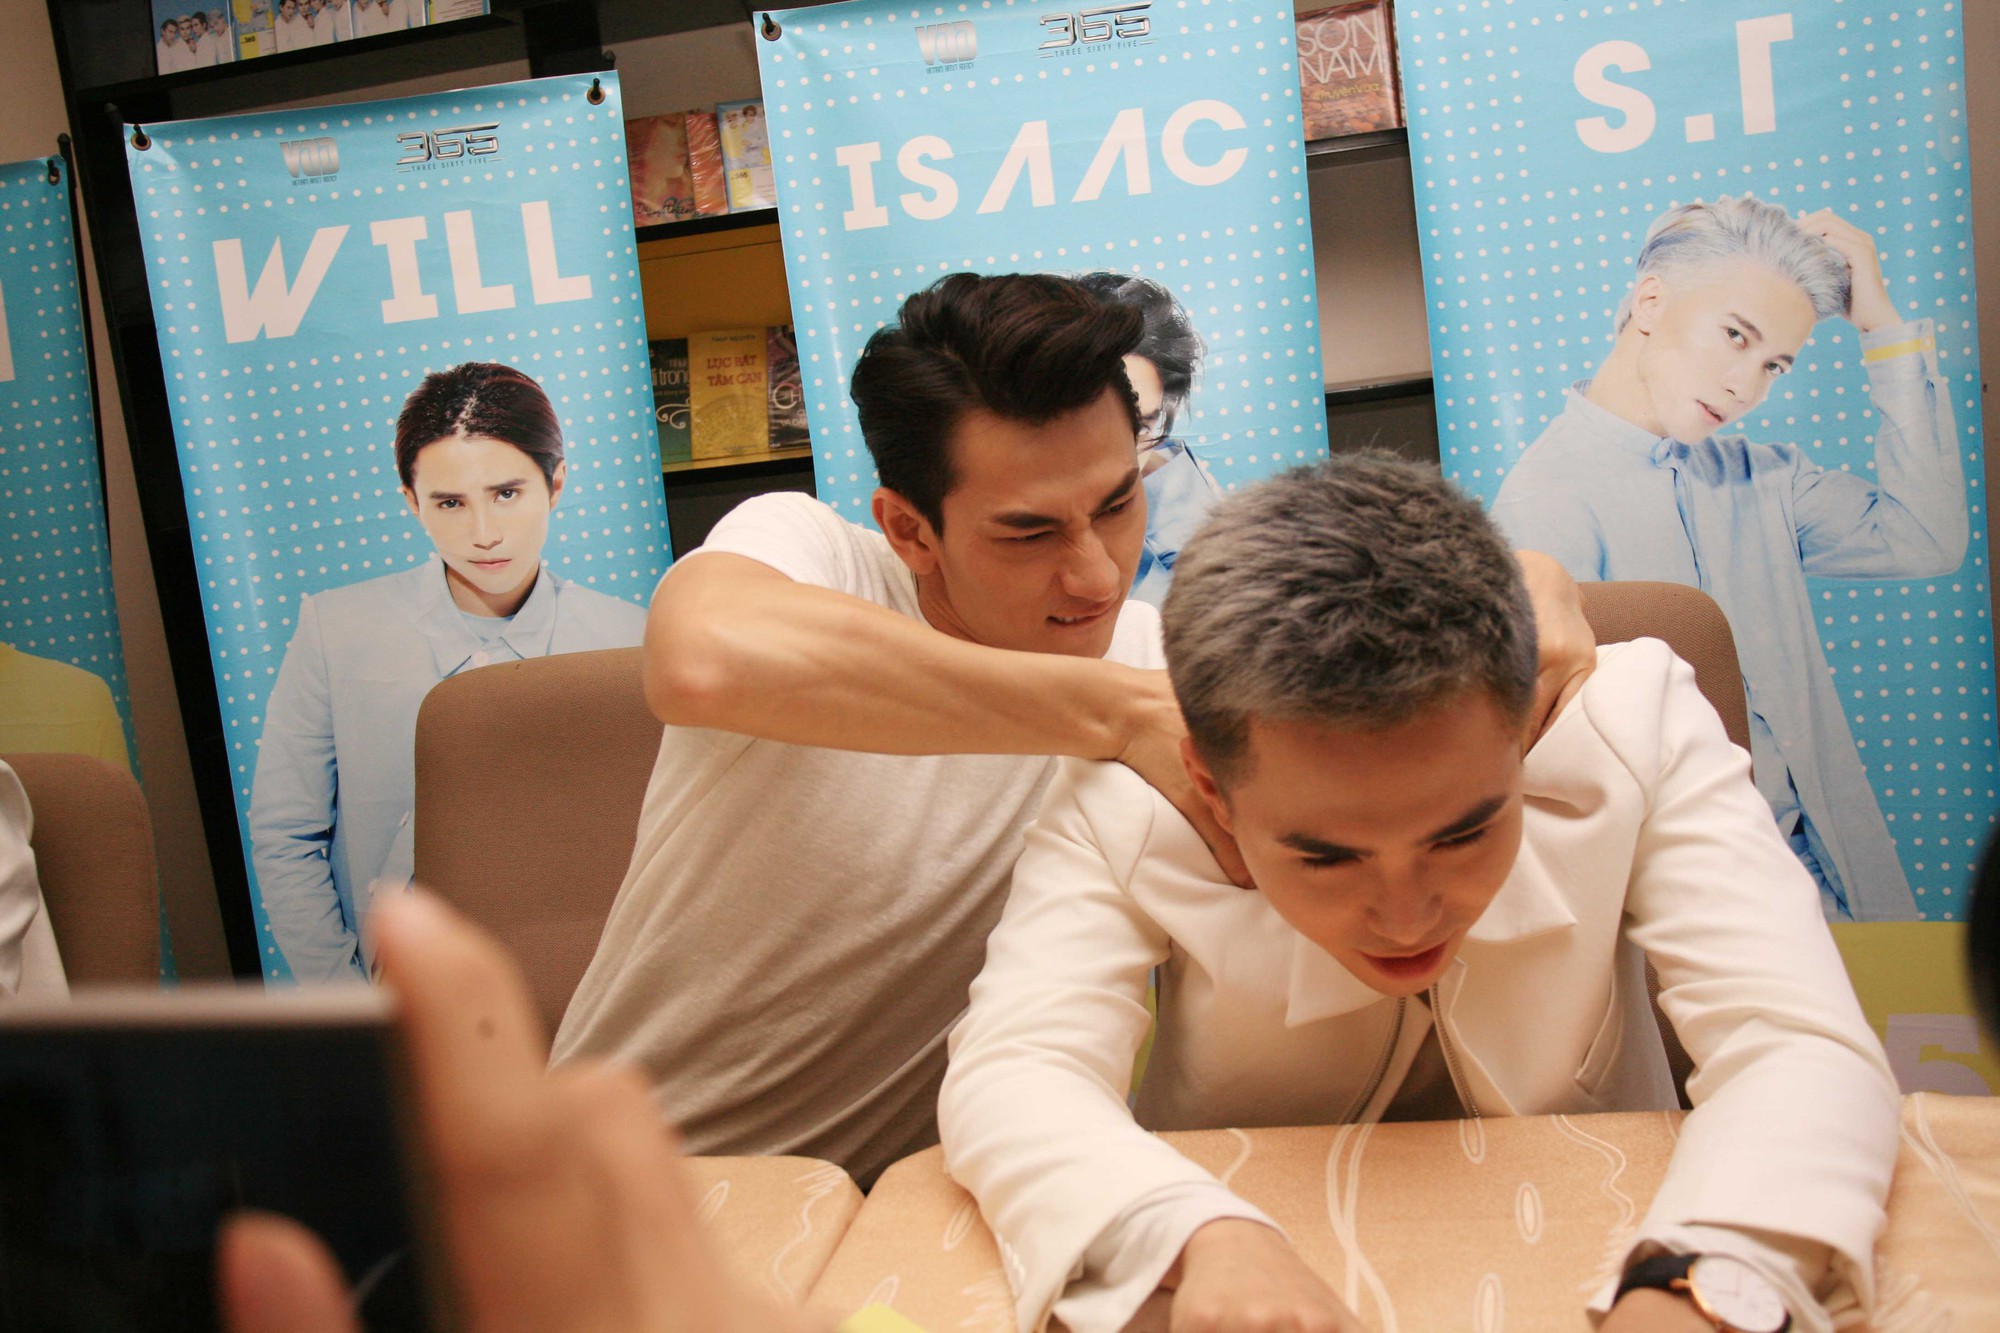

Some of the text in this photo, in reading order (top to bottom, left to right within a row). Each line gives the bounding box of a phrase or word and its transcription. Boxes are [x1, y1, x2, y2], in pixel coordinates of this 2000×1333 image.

[1038, 2, 1153, 50] 365
[1054, 40, 1138, 58] THREE SIXTY FIVE
[1298, 43, 1384, 88] NAM
[396, 121, 501, 166] 365
[411, 158, 488, 173] THREE SIXTY FIVE
[834, 98, 1250, 232] ISAAC
[212, 199, 594, 344] WILL
[659, 368, 689, 387] tron
